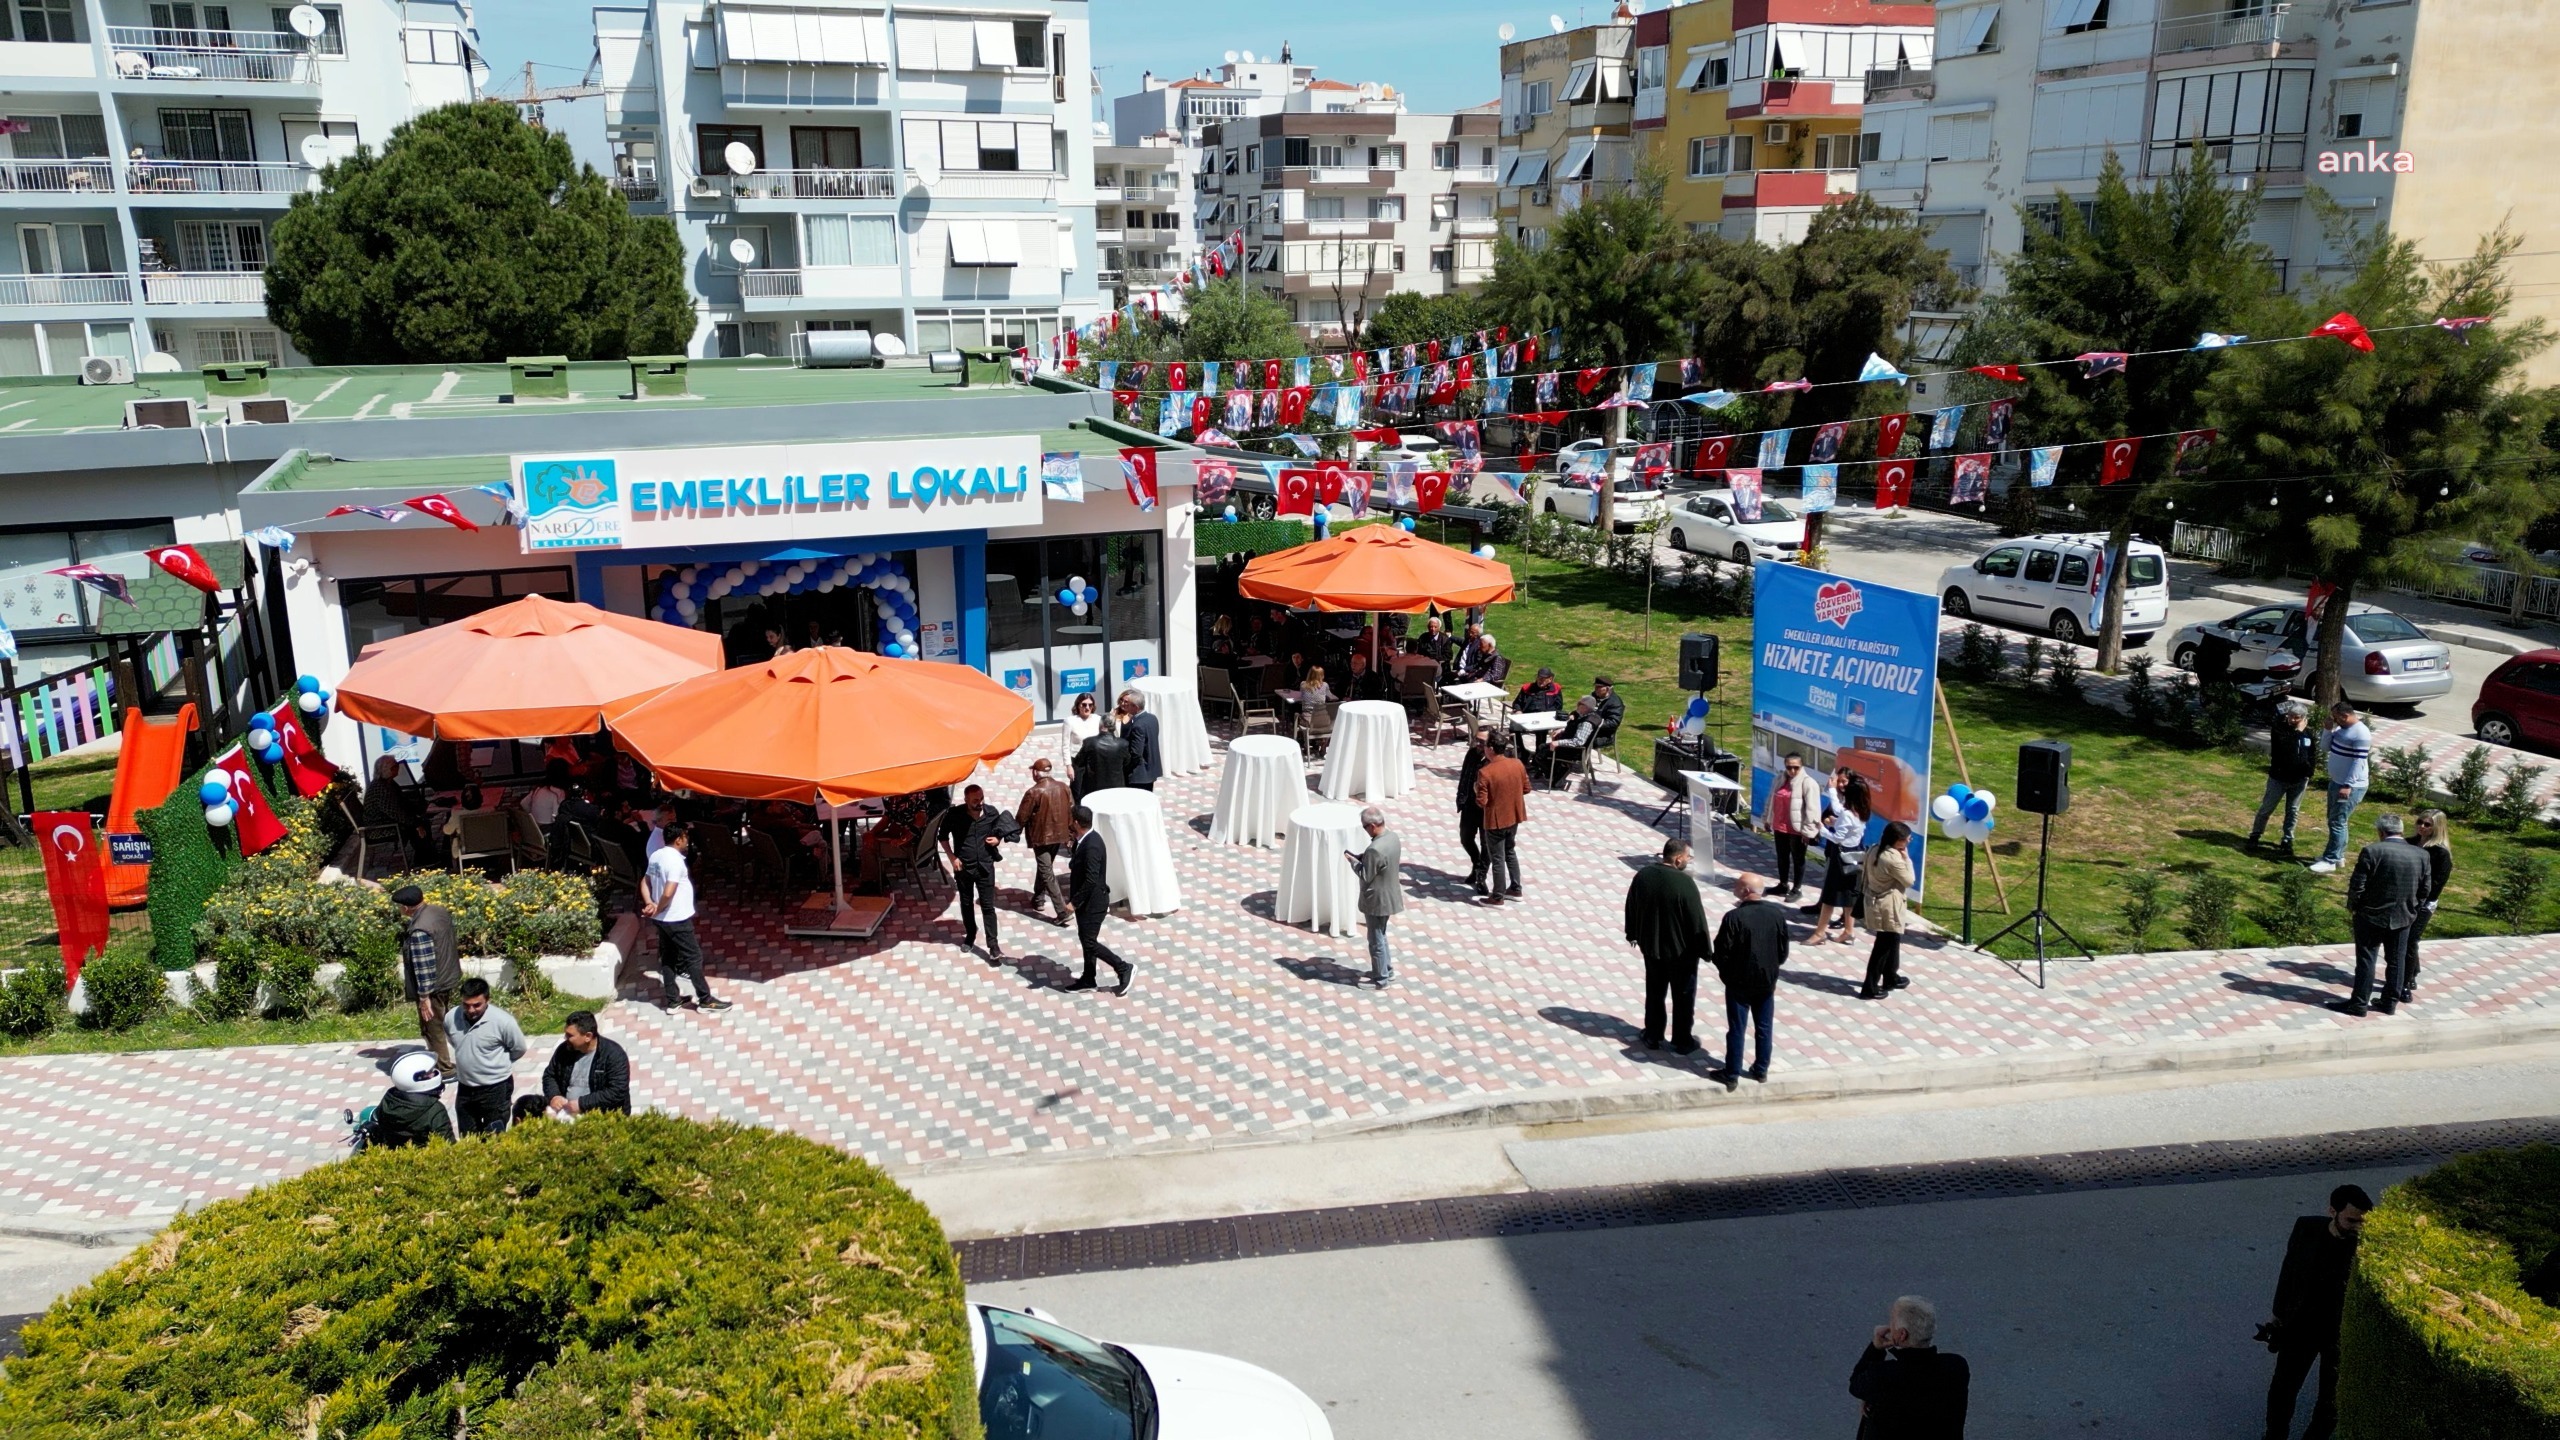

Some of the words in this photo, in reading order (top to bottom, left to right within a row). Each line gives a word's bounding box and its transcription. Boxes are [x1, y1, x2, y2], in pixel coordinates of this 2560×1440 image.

[1817, 602, 1862, 621] YAPIYORUZ
[1784, 628, 1821, 645] EMEKLİLER
[1820, 634, 1848, 649] LOKALİ
[1847, 638, 1858, 650] VE
[1831, 655, 1924, 695] AÇIYORUZ
[1809, 685, 1838, 700] ERMAN
[1809, 693, 1837, 711] UZUN
[112, 841, 151, 854] SARIŞIN
